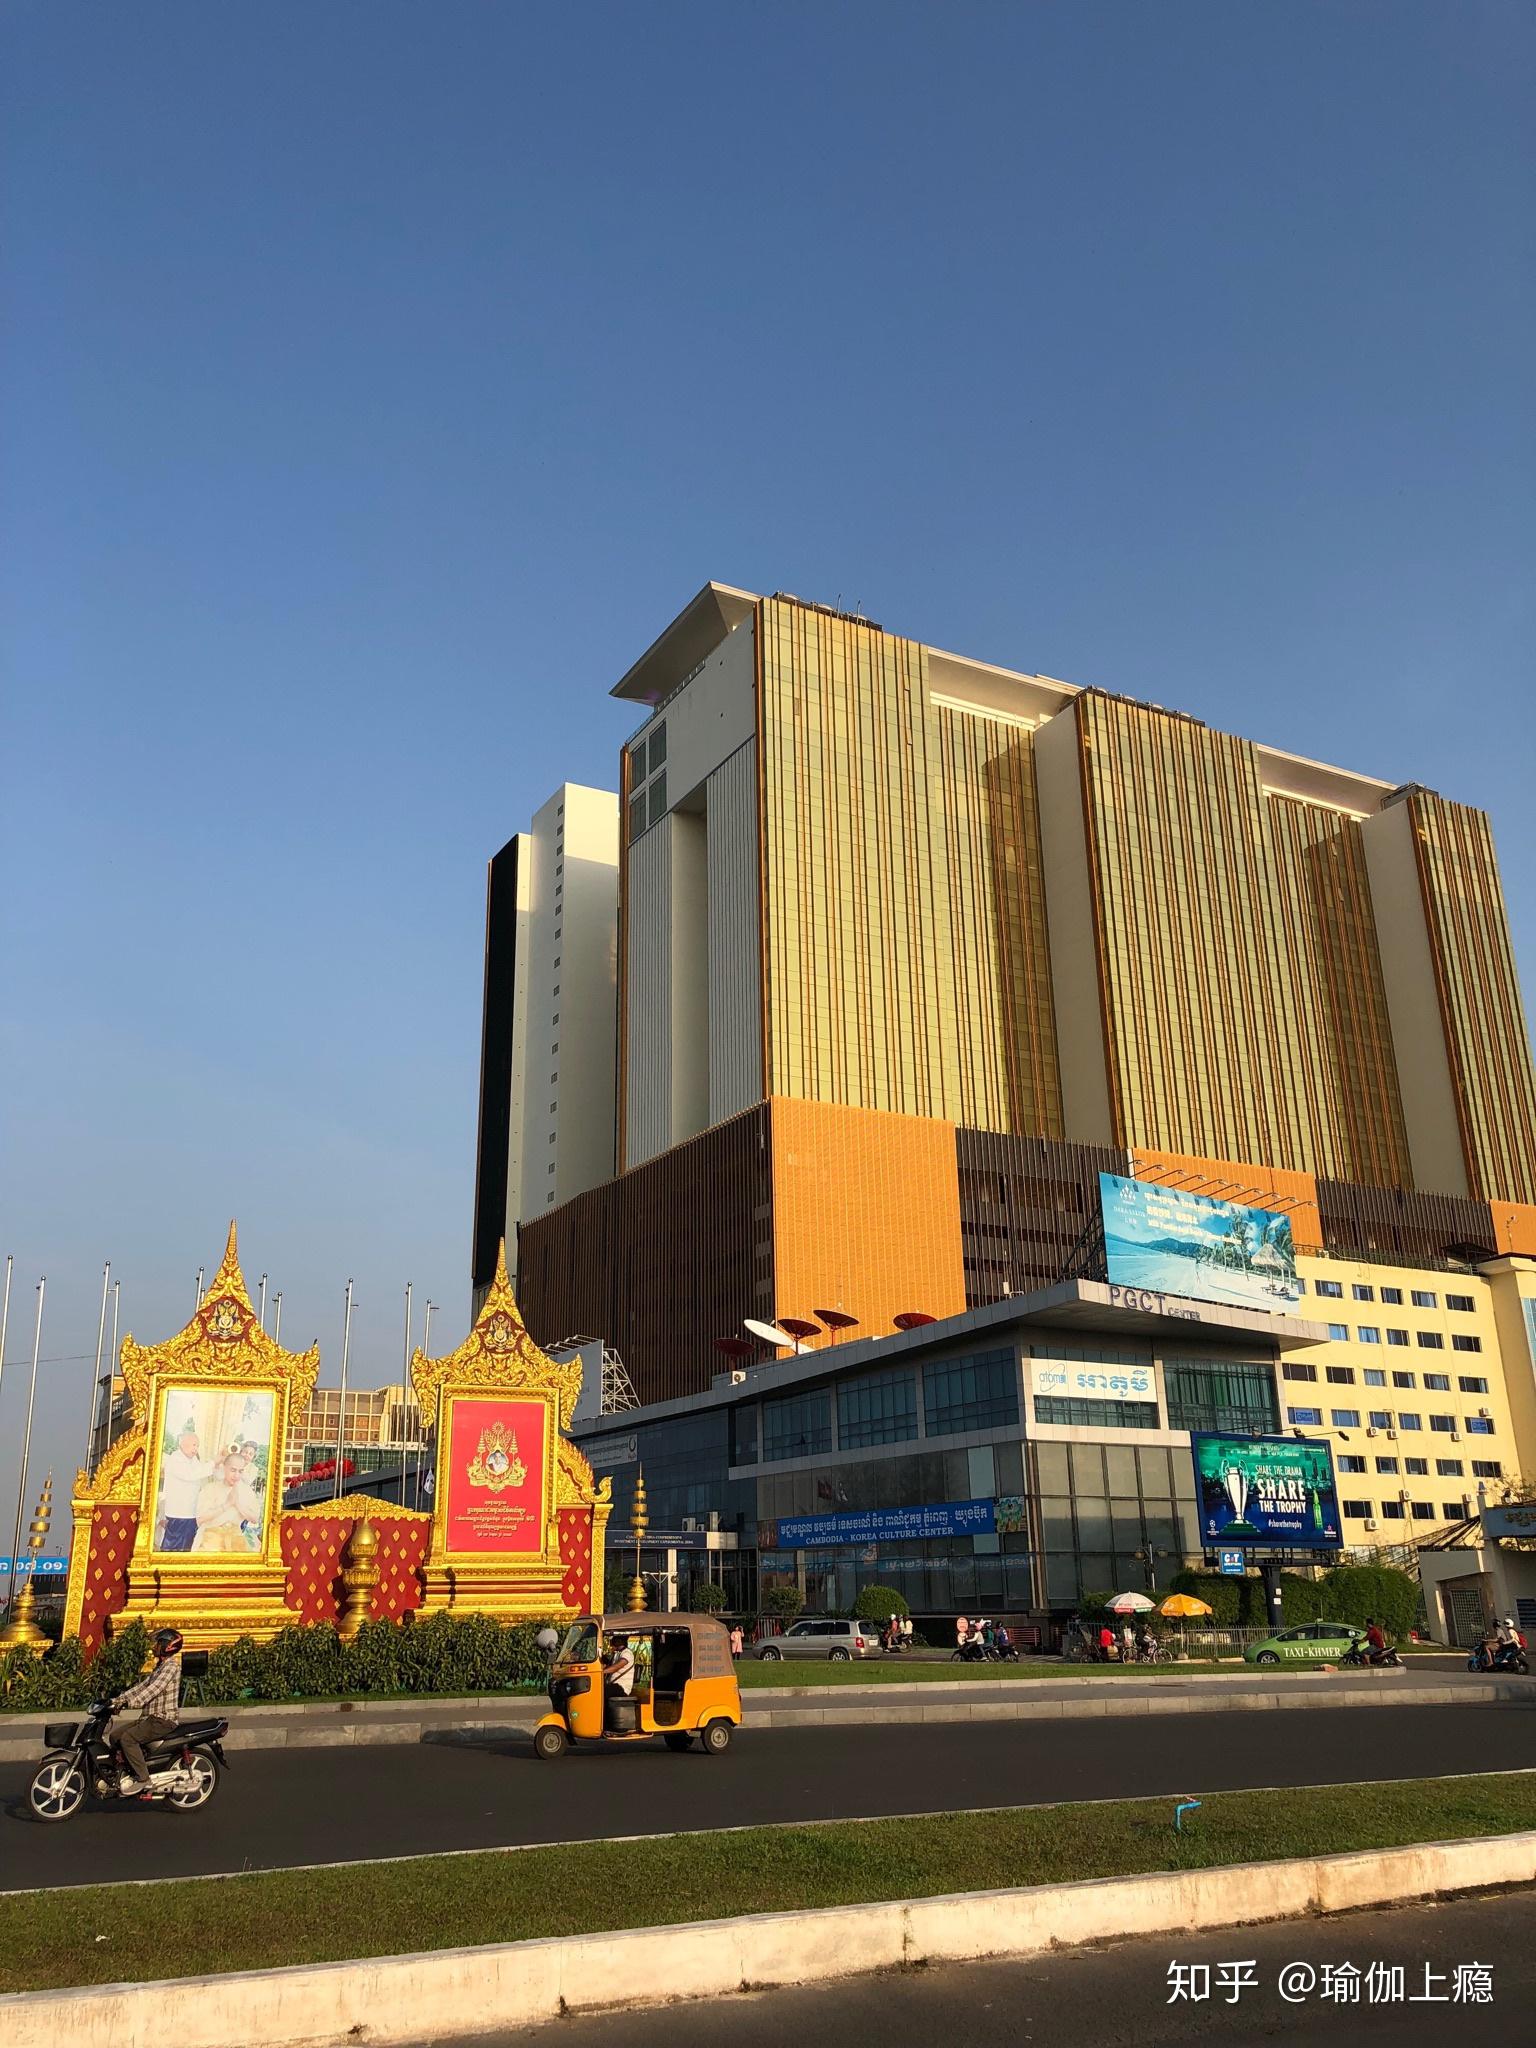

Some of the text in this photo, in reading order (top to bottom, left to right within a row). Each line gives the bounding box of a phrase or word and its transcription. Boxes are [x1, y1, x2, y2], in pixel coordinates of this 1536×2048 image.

[1109, 1286, 1166, 1315] PGCT
[1255, 1464, 1303, 1477] SHARE THE DRAMA
[1257, 1478, 1306, 1500] SHARE
[1259, 1500, 1306, 1514] THE TROPHY
[806, 1536, 844, 1545] CAMBODIA
[850, 1533, 877, 1542] KOREA
[879, 1529, 917, 1539] CULTURE
[919, 1527, 954, 1537] CENTER
[1283, 1646, 1343, 1658] TAXI-KHMER
